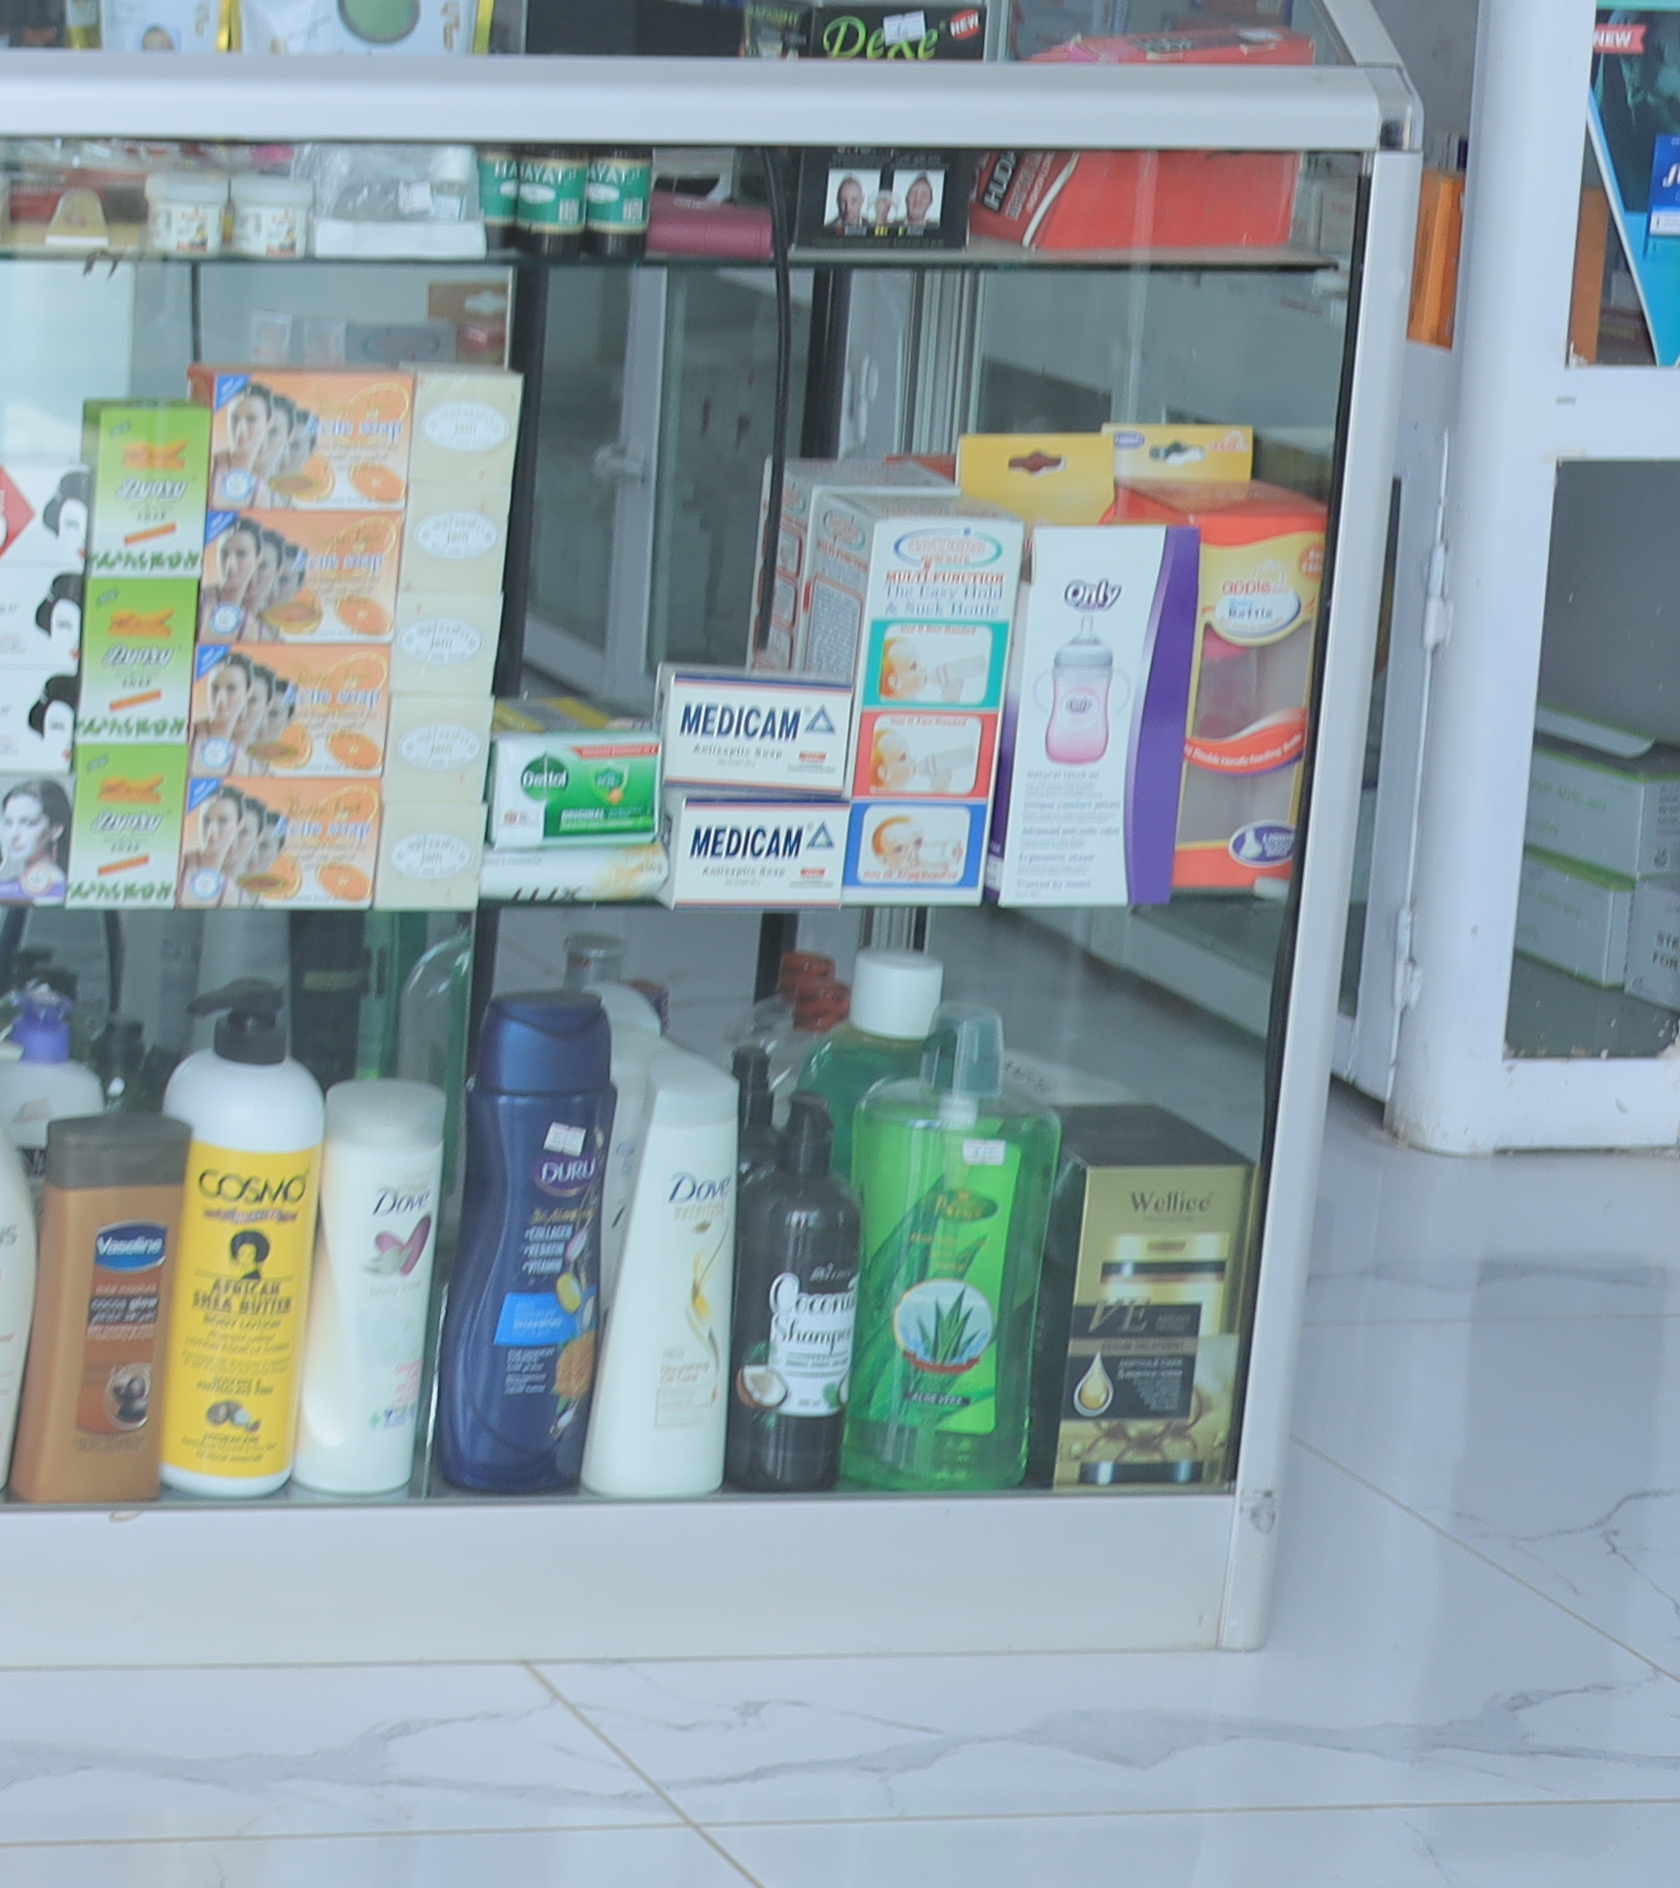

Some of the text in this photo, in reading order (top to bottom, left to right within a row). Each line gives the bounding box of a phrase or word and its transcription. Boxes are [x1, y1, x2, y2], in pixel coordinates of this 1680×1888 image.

[949, 11, 981, 38] NEW
[1064, 579, 1123, 612] Only
[679, 702, 802, 742] MEDICAM
[521, 772, 569, 789] Dettol
[690, 826, 803, 860] MEDICAM
[540, 1158, 597, 1181] DURU
[198, 1168, 307, 1205] COSMO
[371, 1187, 432, 1217] Dove
[667, 1170, 734, 1206] Dove
[96, 1234, 164, 1256] Vaseline
